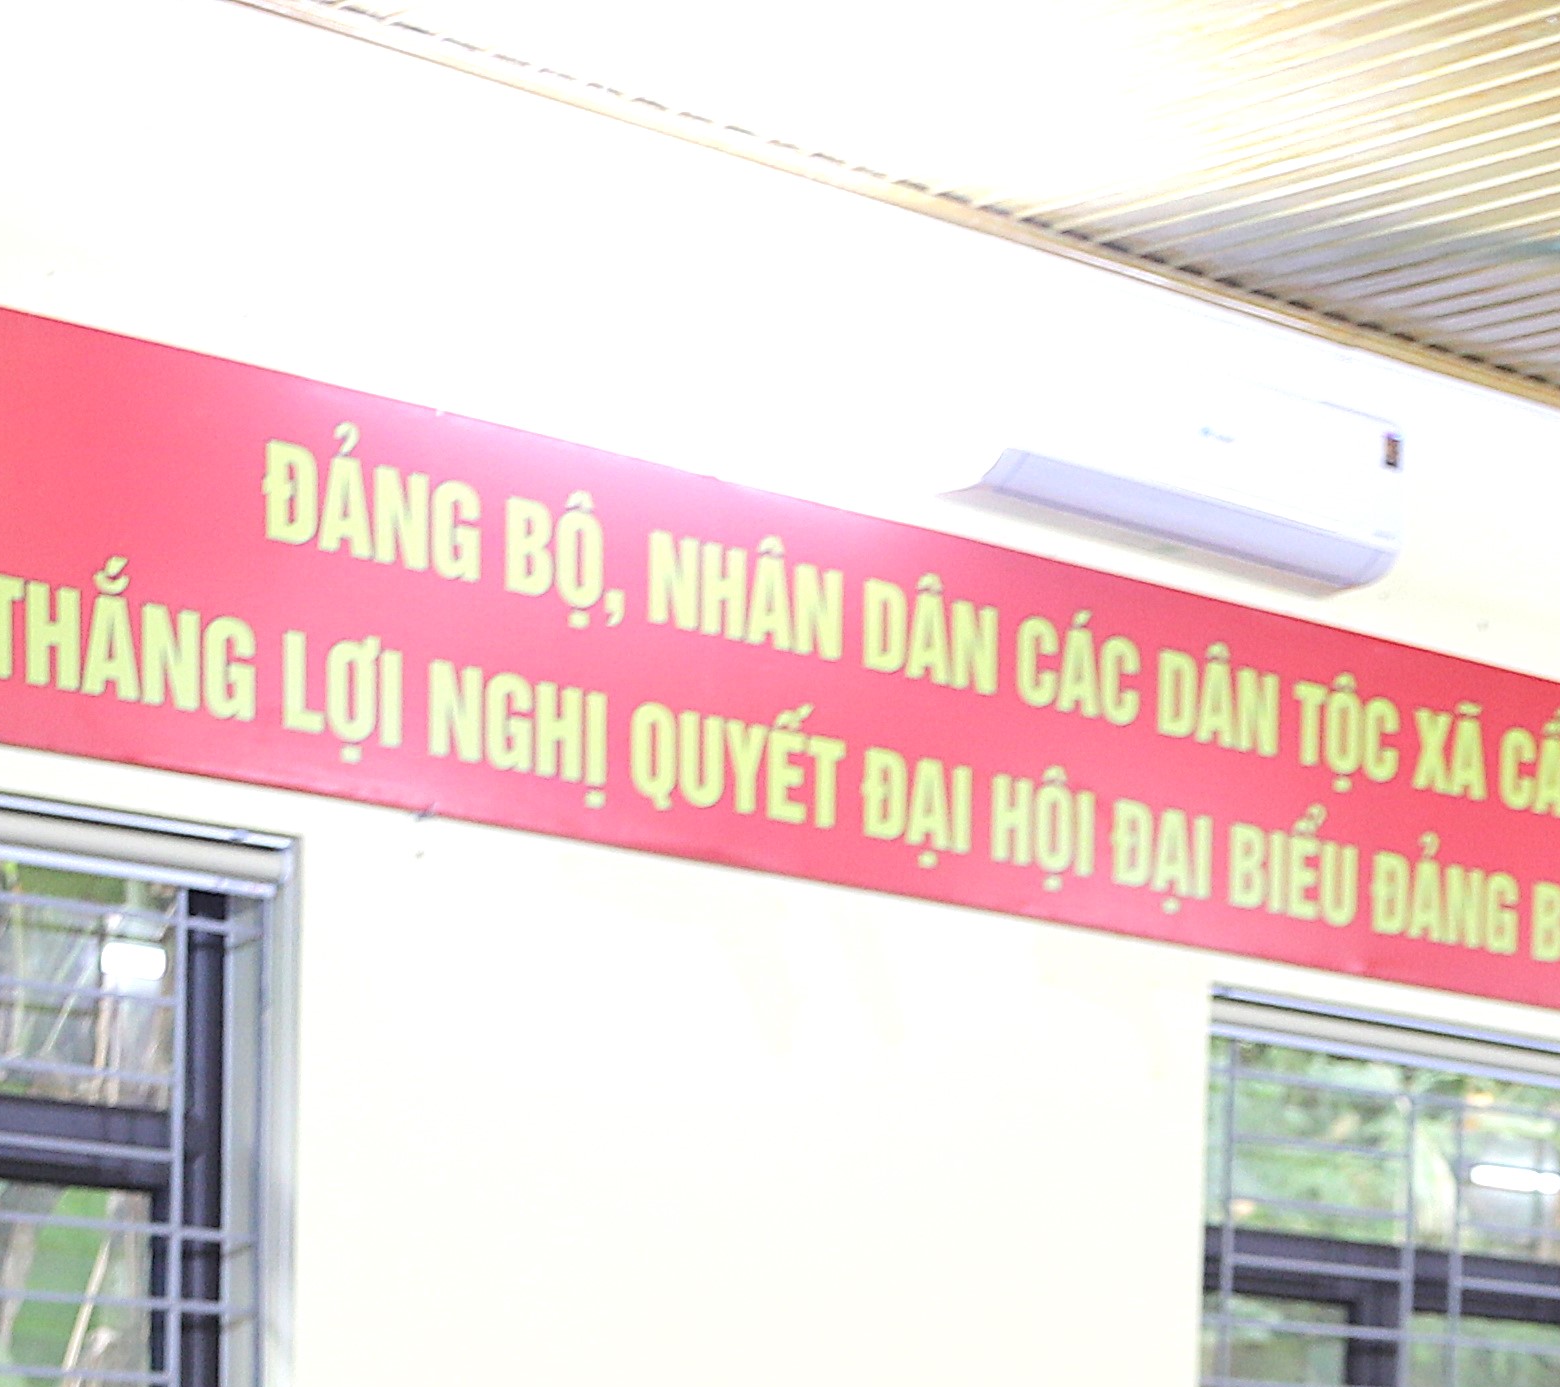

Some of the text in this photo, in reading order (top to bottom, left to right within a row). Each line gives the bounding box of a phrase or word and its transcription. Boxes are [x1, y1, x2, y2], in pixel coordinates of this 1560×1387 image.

[262, 421, 481, 583] ĐẢNG
[505, 490, 625, 630] BỘ,
[647, 528, 844, 662] NHÂN
[863, 573, 999, 696] DÂN
[1016, 609, 1140, 727] CÁC
[1156, 642, 1280, 757] DÂN
[1294, 673, 1400, 793] TỘC
[1412, 702, 1487, 803] XÃ
[282, 630, 403, 764] LỢI
[428, 658, 608, 810] NGHỊ
[630, 703, 847, 830] QUYẾT
[860, 747, 973, 872] ĐẠI
[991, 765, 1096, 905] HỘI
[1111, 797, 1213, 915] ĐẠI
[1229, 803, 1359, 928] BIỂU
[1371, 832, 1520, 957] ĐẢNG
